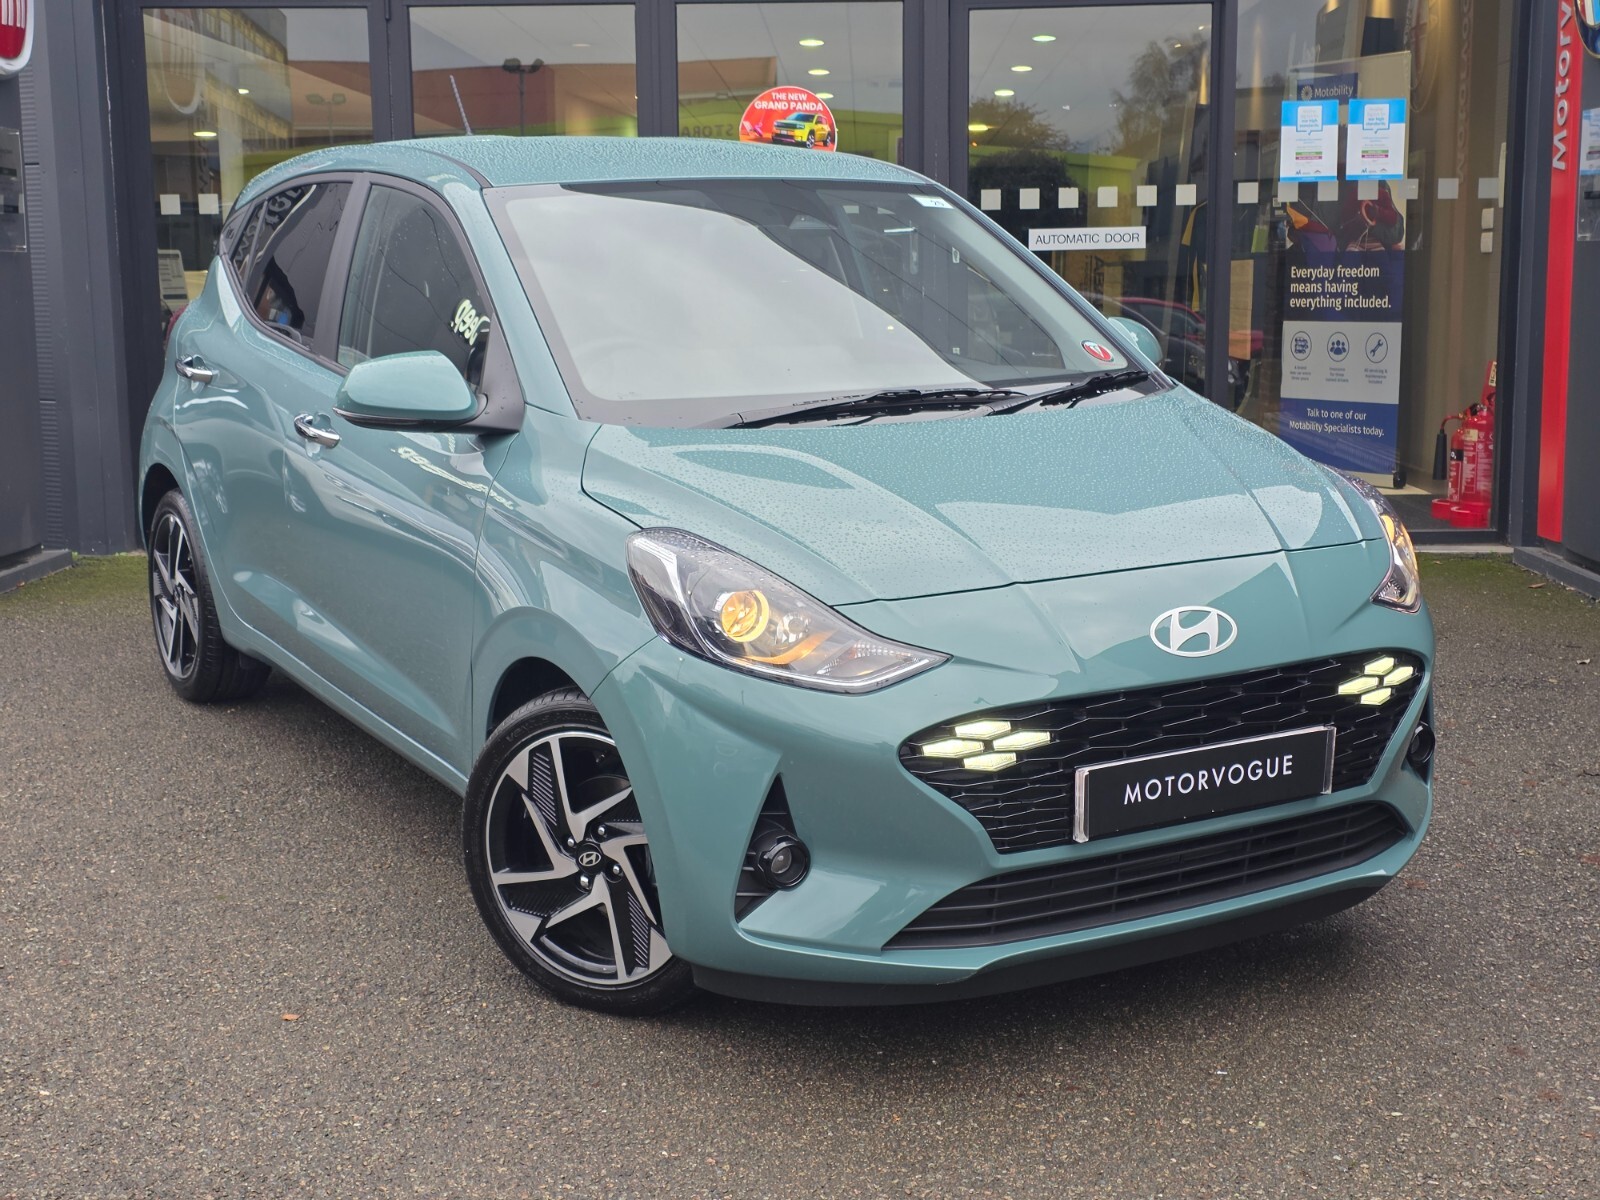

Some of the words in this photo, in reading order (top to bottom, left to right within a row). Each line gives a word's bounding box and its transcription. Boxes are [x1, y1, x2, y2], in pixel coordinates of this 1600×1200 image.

[771, 92, 787, 101] THE
[788, 93, 808, 101] NEW
[754, 101, 788, 110] GRAND
[790, 102, 823, 111] PANDA
[1035, 233, 1100, 245] AUTOMATIC
[1105, 232, 1140, 243] DOOR
[1291, 265, 1334, 281] Everyday
[1337, 264, 1380, 278] freedom
[1290, 283, 1322, 293] means
[1325, 279, 1358, 295] having
[1289, 294, 1342, 311] everything
[1344, 294, 1392, 308] included.
[1307, 408, 1320, 417] Talk
[1321, 410, 1329, 418] to
[1330, 411, 1343, 419] one
[1345, 410, 1353, 420] of
[1354, 412, 1367, 420] our
[1324, 423, 1362, 434] Specialists
[1363, 426, 1385, 438] today.
[1123, 754, 1293, 805] MOTORVOGUE
